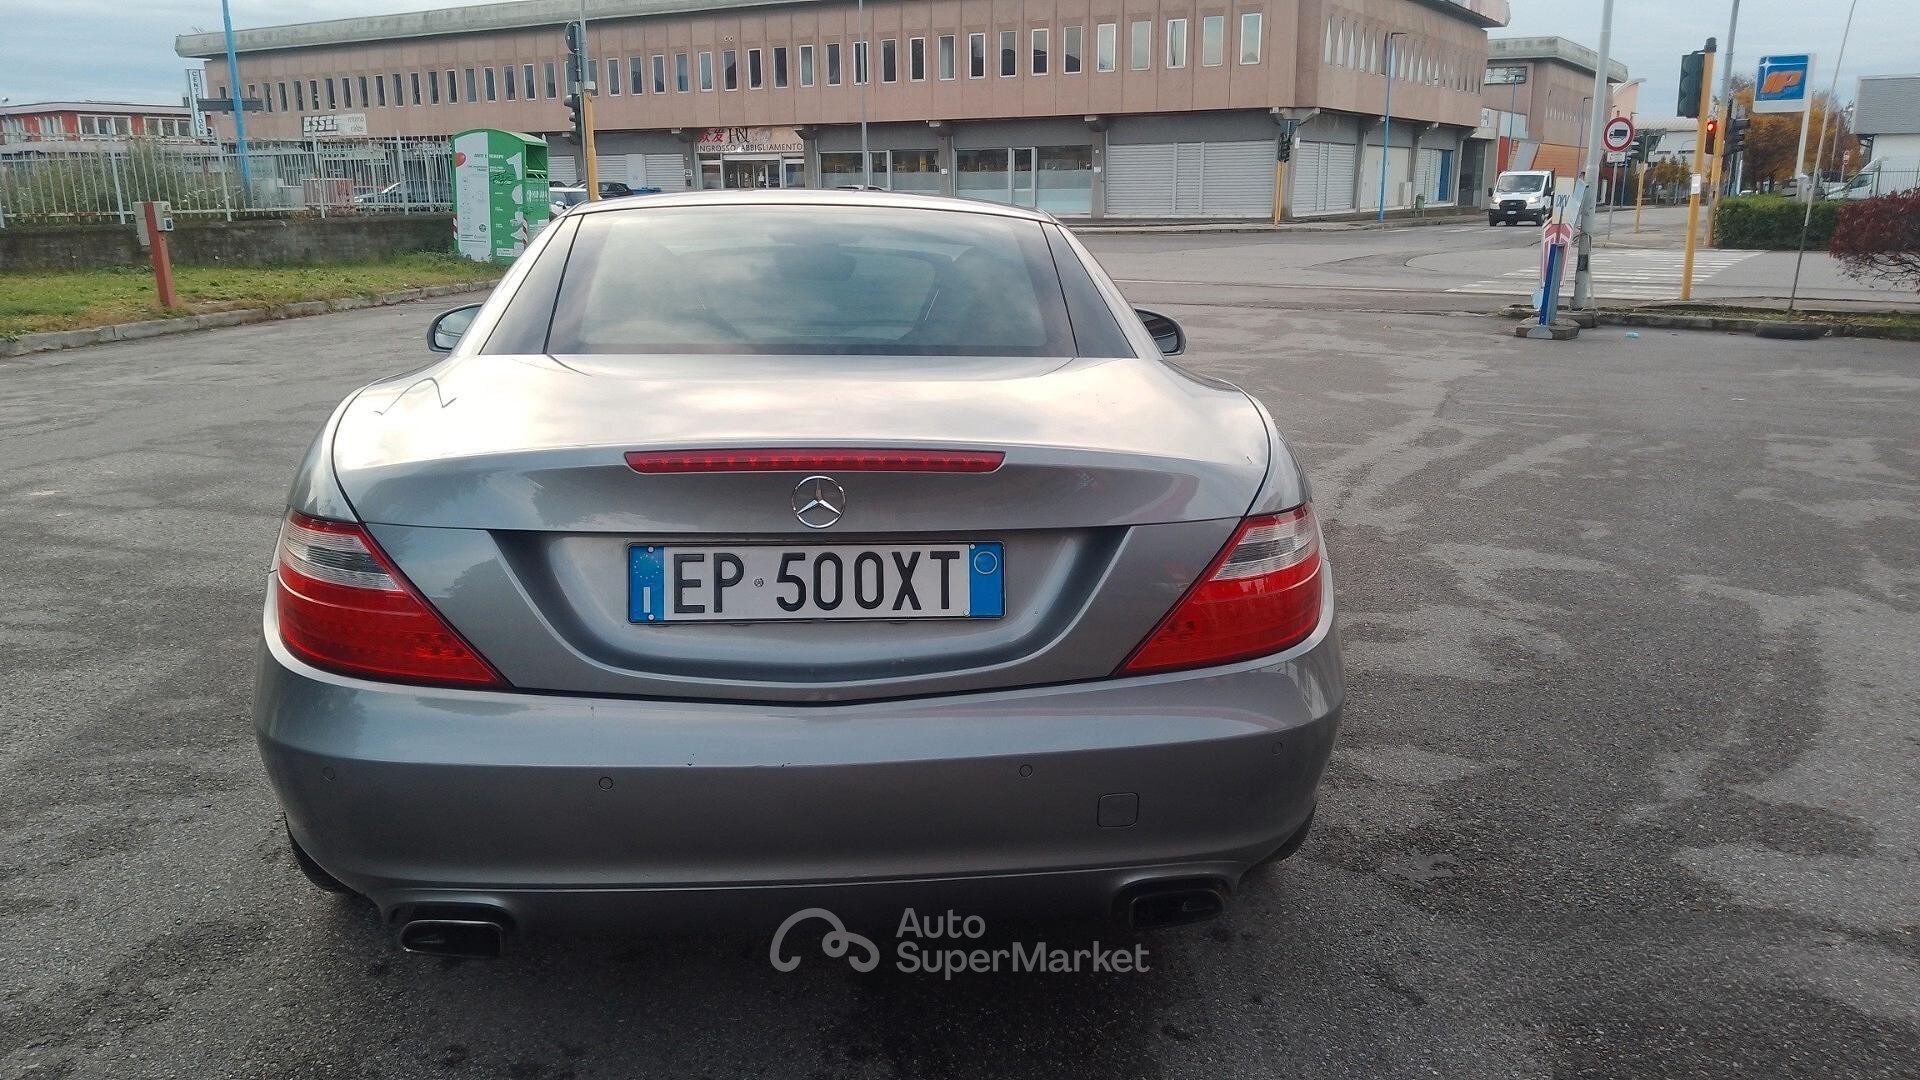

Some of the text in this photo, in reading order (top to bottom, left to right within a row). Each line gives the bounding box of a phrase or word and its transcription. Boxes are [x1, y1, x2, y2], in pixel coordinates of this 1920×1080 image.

[1761, 70, 1803, 94] IP
[698, 143, 803, 152] INGROSSO ABBIGLIAMENTO
[673, 552, 745, 613] EP
[776, 550, 960, 612] 500XT
